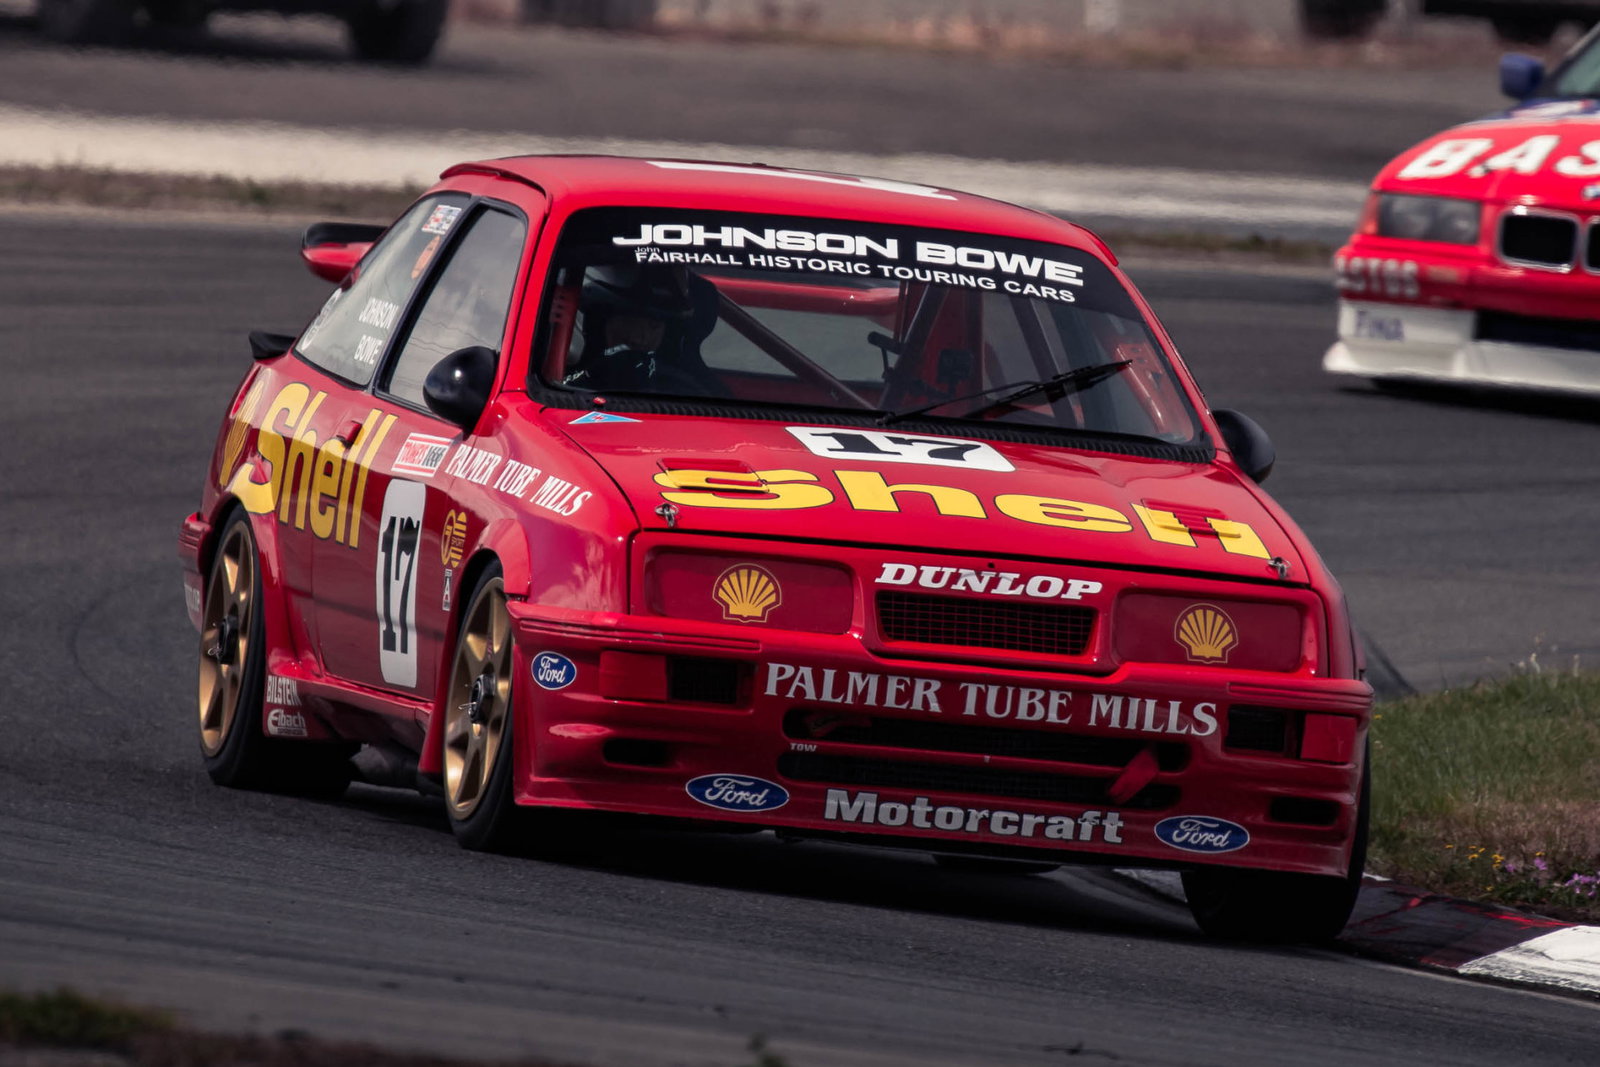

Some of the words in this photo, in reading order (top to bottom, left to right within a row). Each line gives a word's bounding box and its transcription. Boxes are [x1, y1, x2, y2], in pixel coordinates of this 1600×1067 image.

[612, 223, 899, 259] JOHNSON
[916, 241, 1084, 287] BOWE
[634, 245, 660, 253] John
[635, 251, 743, 266] FAIRHALL
[748, 253, 871, 275] HISTORIC
[877, 264, 997, 290] TOURING
[1003, 280, 1076, 303] CARS
[227, 382, 400, 550] Shell
[811, 431, 984, 463] 17
[444, 443, 503, 486] PALMER
[493, 458, 542, 499] TUBE
[529, 475, 593, 517] MILLS
[652, 468, 1272, 560] Shell
[381, 515, 420, 655] 17
[874, 563, 1102, 600] DUNLOP
[266, 675, 302, 706] BILSTEIN
[538, 655, 567, 684] Ford
[764, 663, 942, 715] PALMER
[959, 682, 1073, 726] TUBE
[1088, 695, 1219, 737] MILLS
[789, 742, 817, 753] TOW
[704, 776, 768, 808] Ford
[823, 788, 1125, 845] Motorcraft
[1171, 818, 1231, 849] Ford
